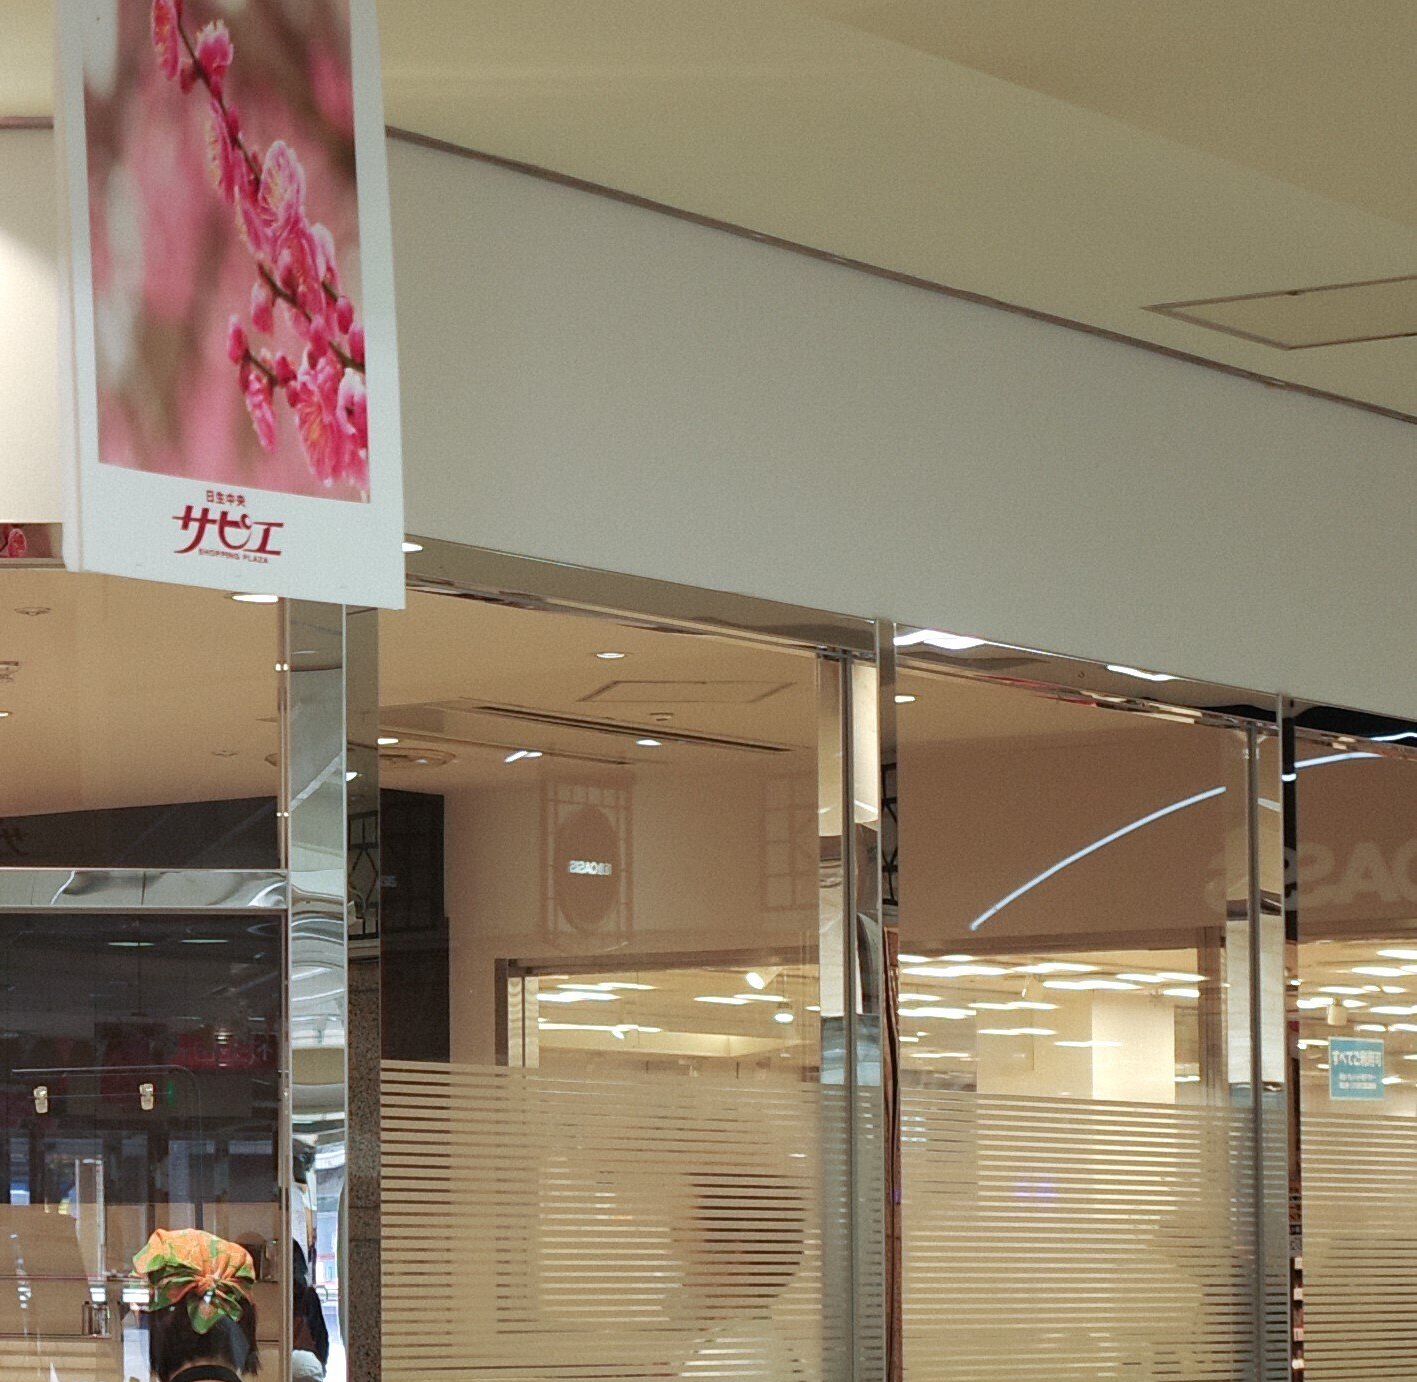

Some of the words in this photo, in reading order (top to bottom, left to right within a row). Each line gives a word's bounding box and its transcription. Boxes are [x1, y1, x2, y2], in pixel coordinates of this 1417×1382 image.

[205, 489, 246, 507] 日生中央
[172, 504, 284, 556] サピエ
[198, 548, 240, 561] SHOPPING
[243, 554, 269, 564] PLAZA
